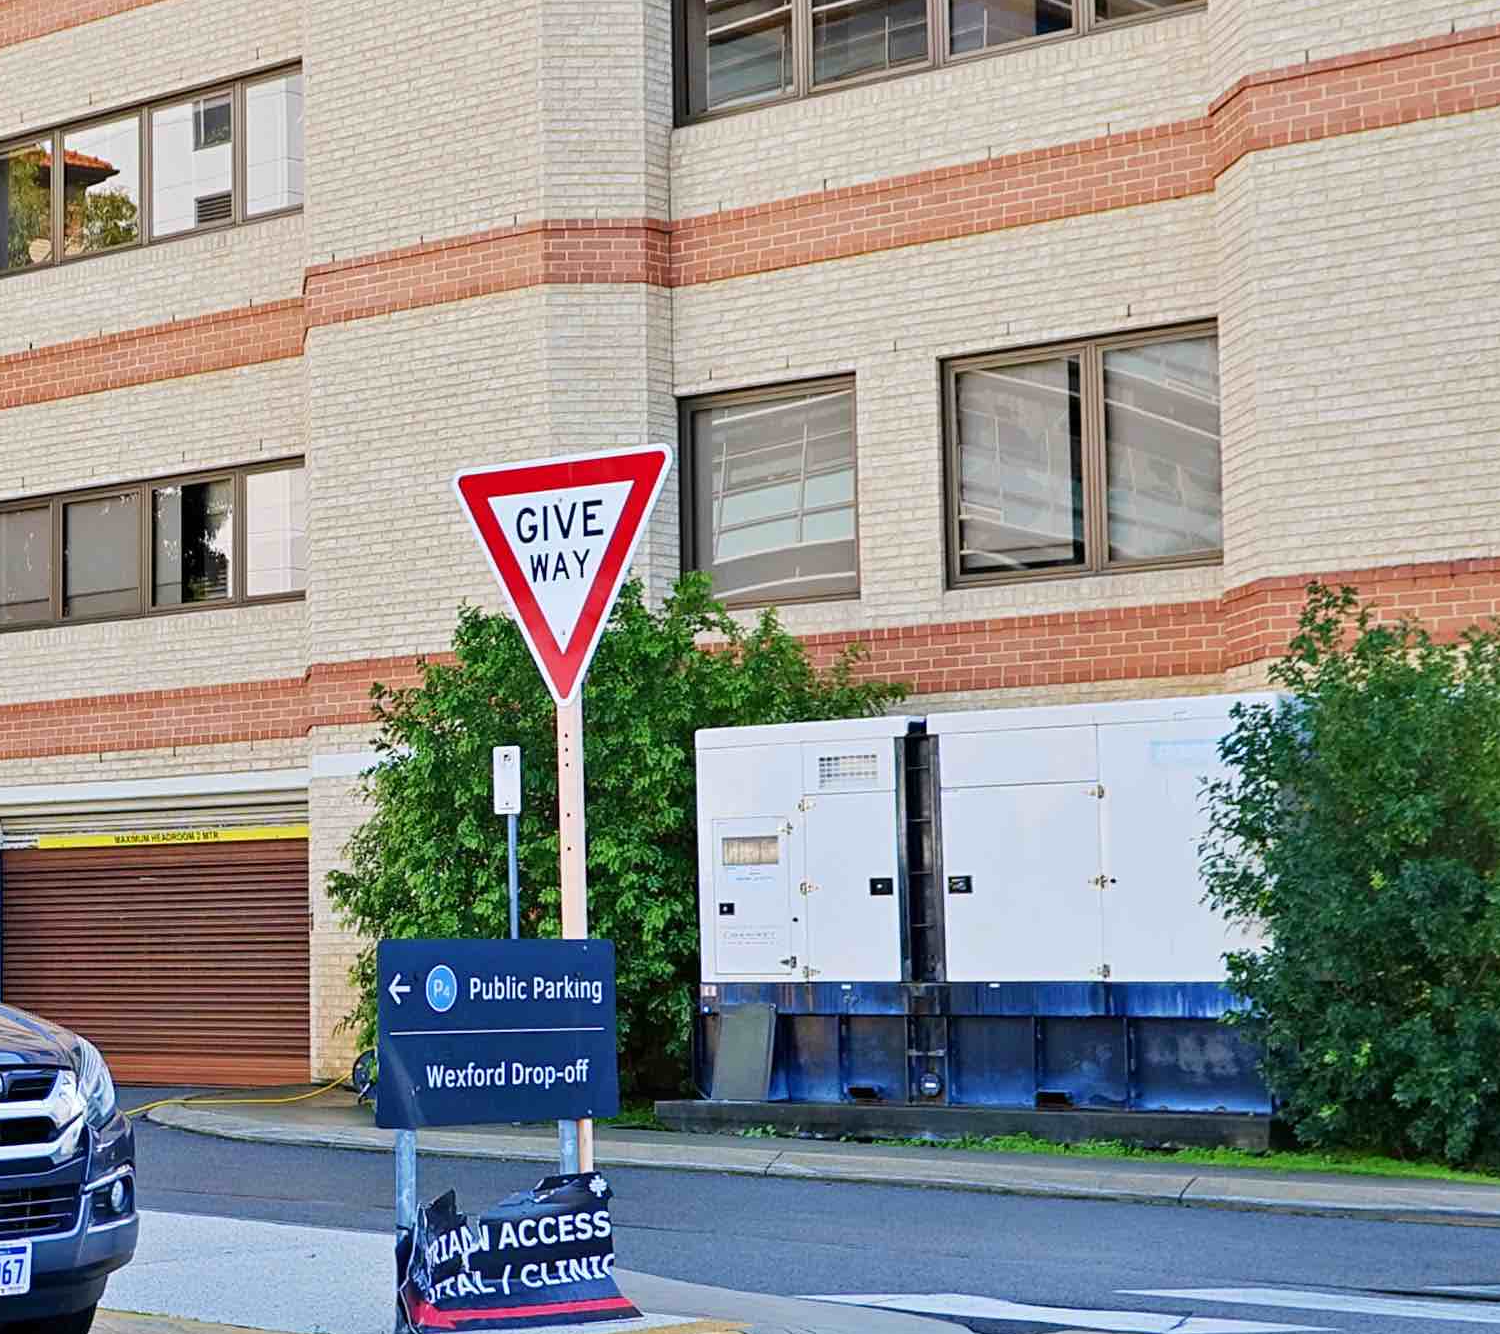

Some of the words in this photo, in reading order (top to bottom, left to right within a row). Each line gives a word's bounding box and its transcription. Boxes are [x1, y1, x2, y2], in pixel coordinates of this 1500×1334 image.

[515, 499, 604, 544] GIVE
[530, 548, 590, 583] WAY
[113, 834, 149, 844] MAXIMUM
[469, 975, 528, 1001] Public
[533, 975, 603, 1004] Parking
[426, 1059, 506, 1089] Wexford
[511, 1058, 590, 1090] Drop-off
[499, 1210, 612, 1250] ACCESS
